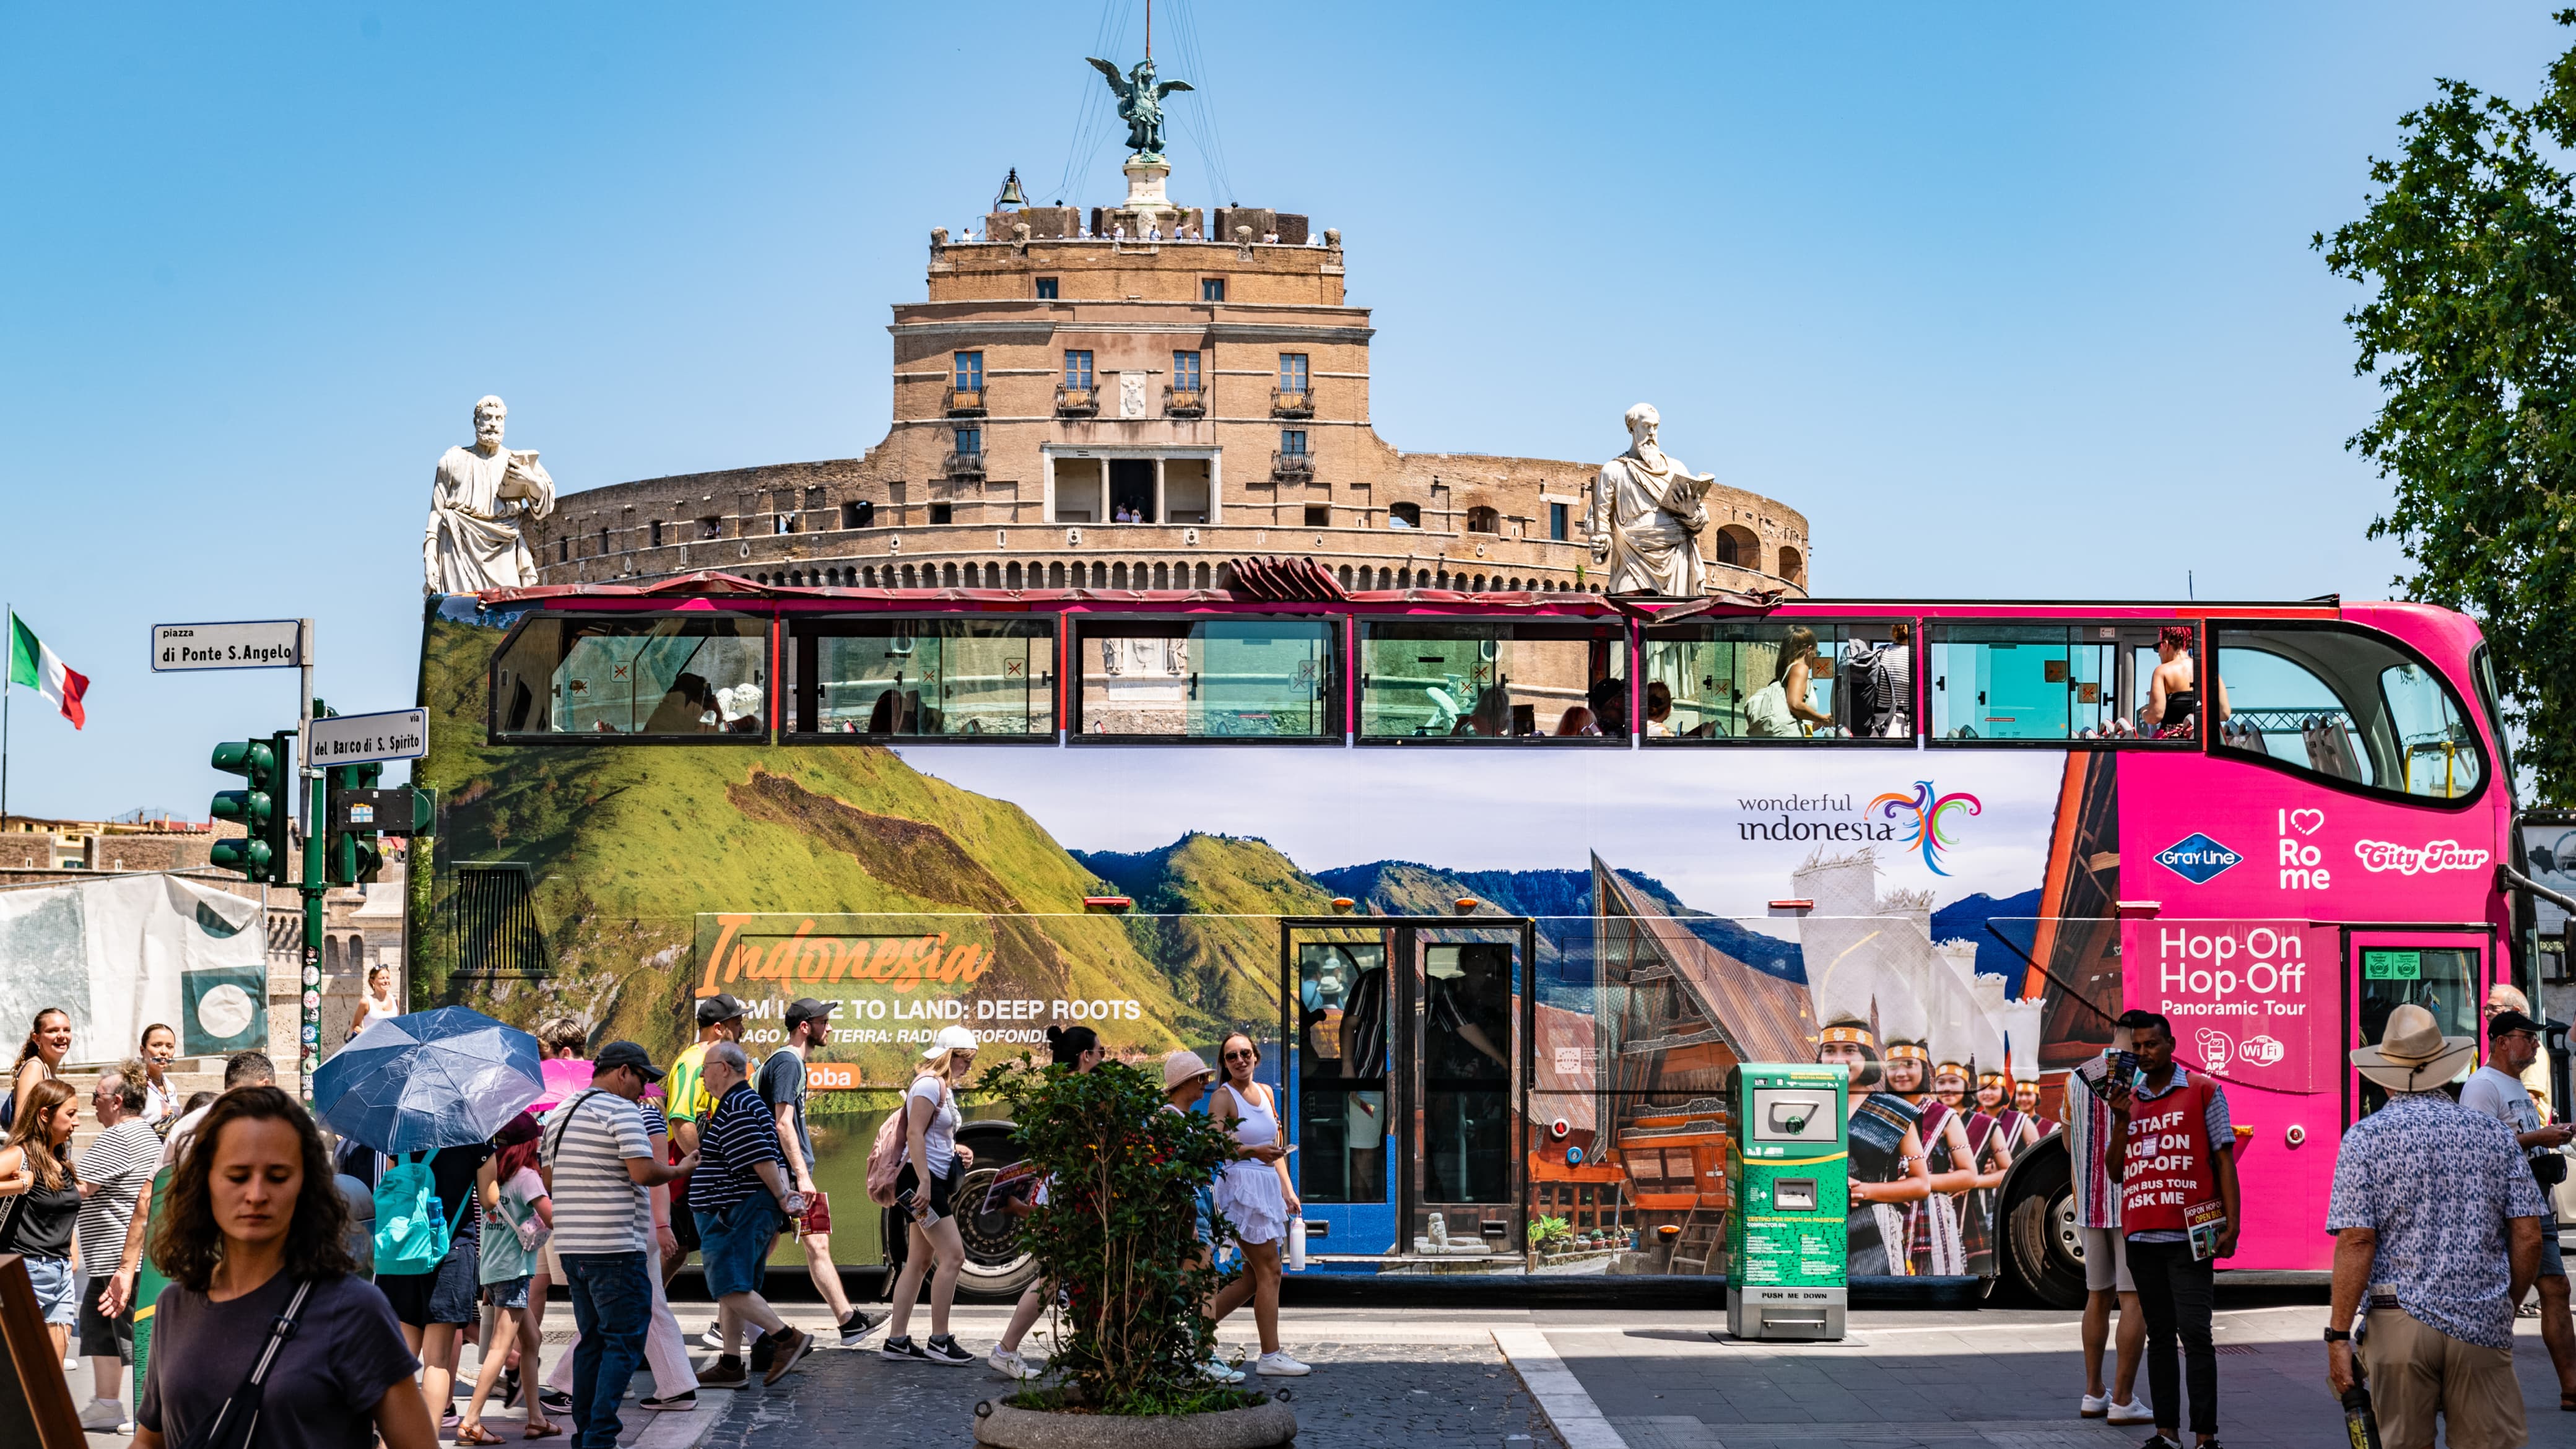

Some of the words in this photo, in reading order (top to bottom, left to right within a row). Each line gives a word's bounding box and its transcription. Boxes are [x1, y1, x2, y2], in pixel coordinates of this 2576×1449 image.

[163, 629, 194, 638] piazza
[162, 647, 175, 662] di
[182, 646, 222, 661] Ponte
[409, 713, 420, 723] via
[315, 741, 328, 756] del
[334, 740, 361, 755] Barco
[363, 738, 372, 752] di
[377, 737, 385, 751] S.
[389, 733, 419, 754] Spirito
[1738, 793, 1853, 812] wonderful
[1738, 814, 1896, 841] indonesia
[2279, 808, 2286, 835] I
[2280, 838, 2321, 867] Ro
[2357, 842, 2419, 872] City
[2424, 842, 2487, 869] Tour
[2280, 868, 2330, 890] me
[694, 914, 994, 998] Indonesia
[2160, 928, 2302, 966] Hop-On
[2160, 962, 2305, 1001] Hop-Off
[851, 999, 886, 1020] TO
[894, 999, 969, 1020] LAND:
[977, 999, 1045, 1020] DEEP
[1052, 999, 1141, 1020] ROOTS
[2161, 1000, 2258, 1016] Panoramic
[2263, 1000, 2306, 1016] Tour
[739, 1029, 781, 1043] AGO
[833, 1029, 892, 1043] TERRA:
[2205, 1062, 2226, 1071] APP
[2127, 1111, 2184, 1136] STAFF
[2141, 1179, 2164, 1190] BUS
[2166, 1179, 2198, 1190] TOUR
[2128, 1193, 2156, 1211] ASK
[2160, 1191, 2185, 1205] ME
[2186, 1208, 2196, 1217] HOP
[2205, 1203, 2216, 1211] HOP
[2195, 1212, 2211, 1224] OPEN
[2211, 1209, 2222, 1219] BUS
